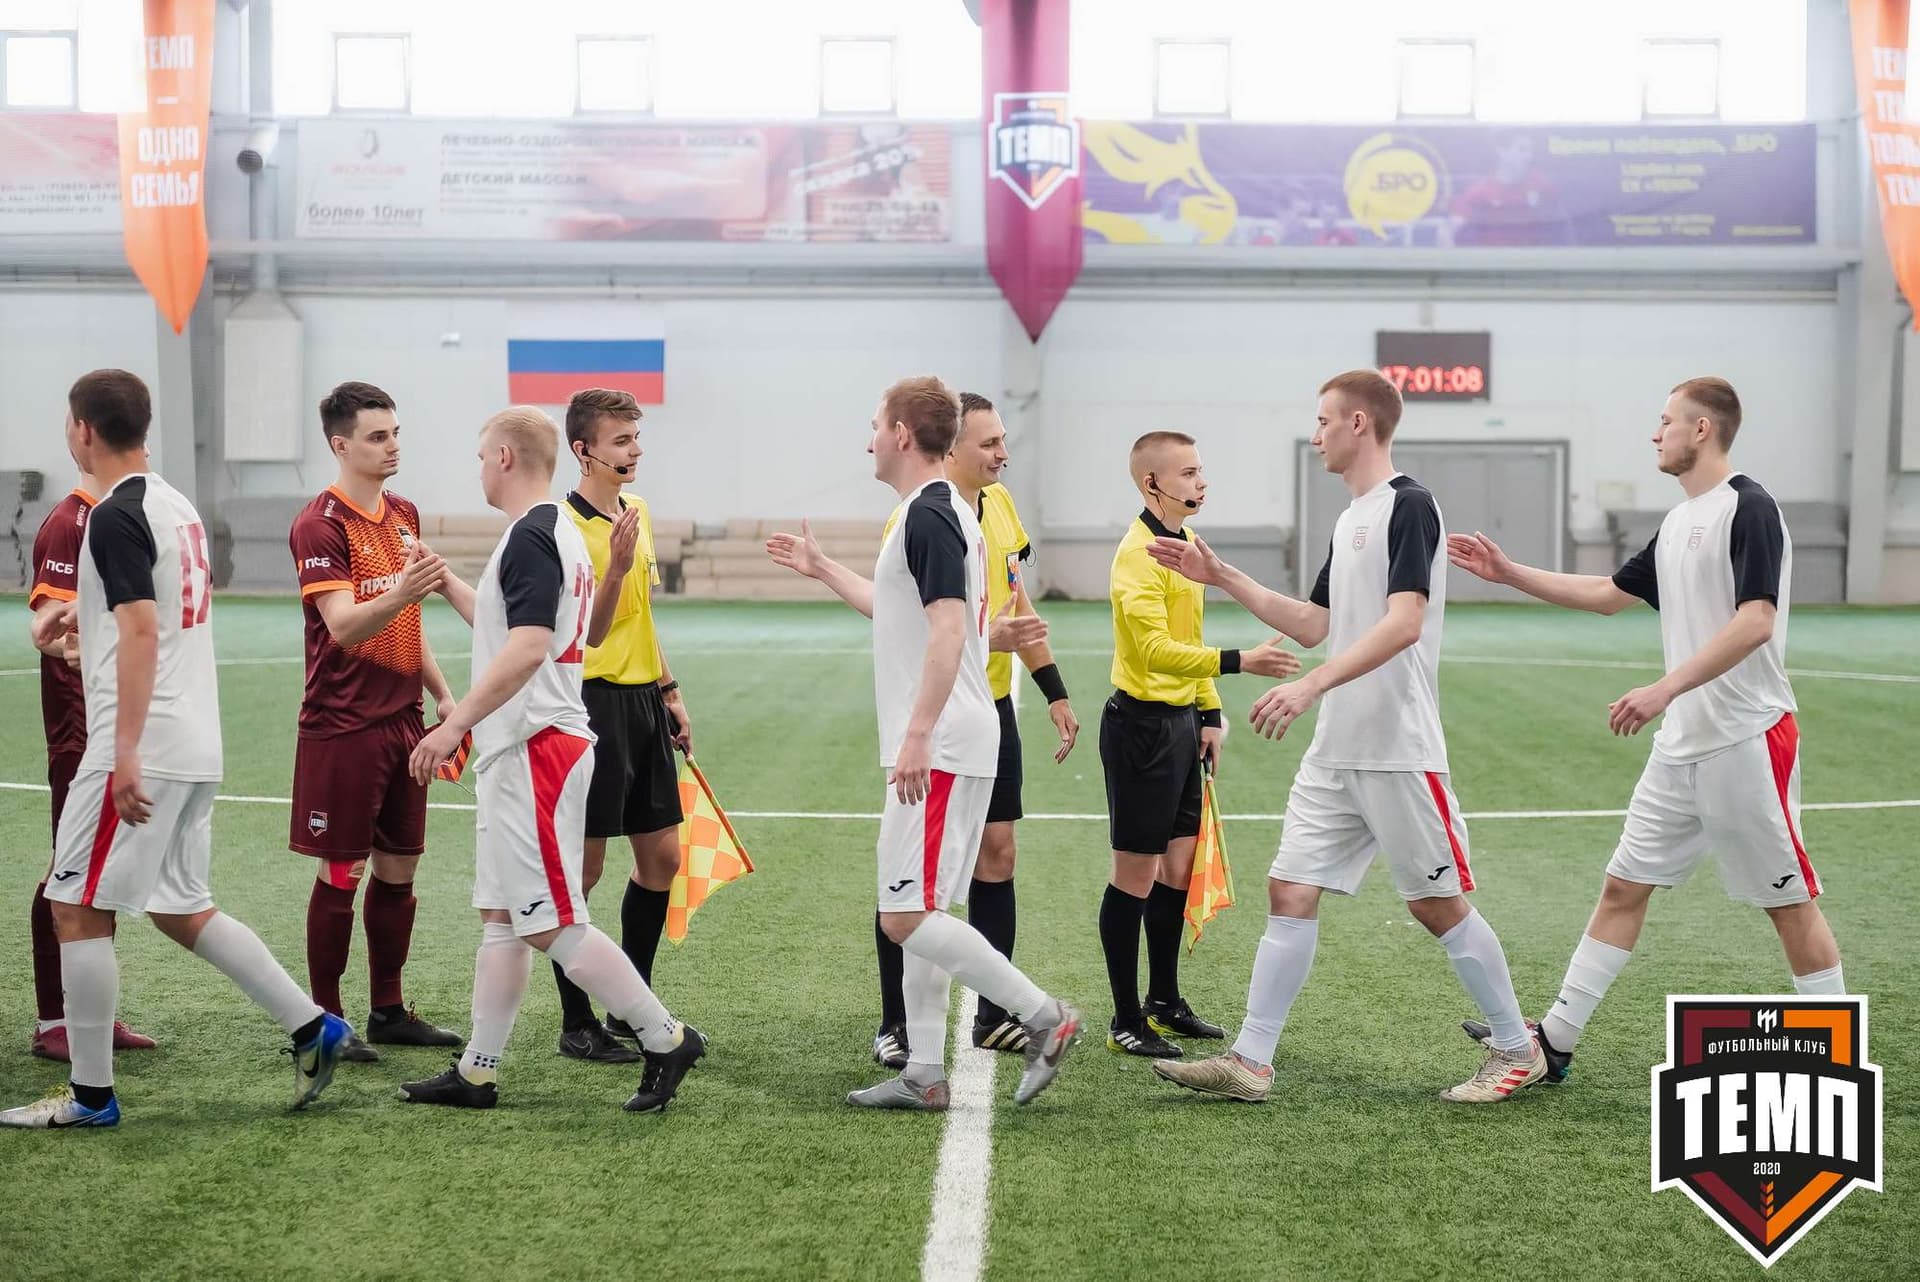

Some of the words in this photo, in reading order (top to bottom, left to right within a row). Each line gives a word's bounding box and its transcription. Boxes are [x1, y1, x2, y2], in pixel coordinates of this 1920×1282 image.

[138, 127, 200, 165] ОДНА
[998, 125, 1070, 166] ТЕМП
[131, 171, 200, 208] СЕМЬЯ
[441, 171, 513, 186] ДЕТСКИЙ
[308, 204, 365, 219] более
[46, 559, 75, 575] ПСБ
[176, 523, 211, 628] 15
[305, 556, 331, 569] ПСБ
